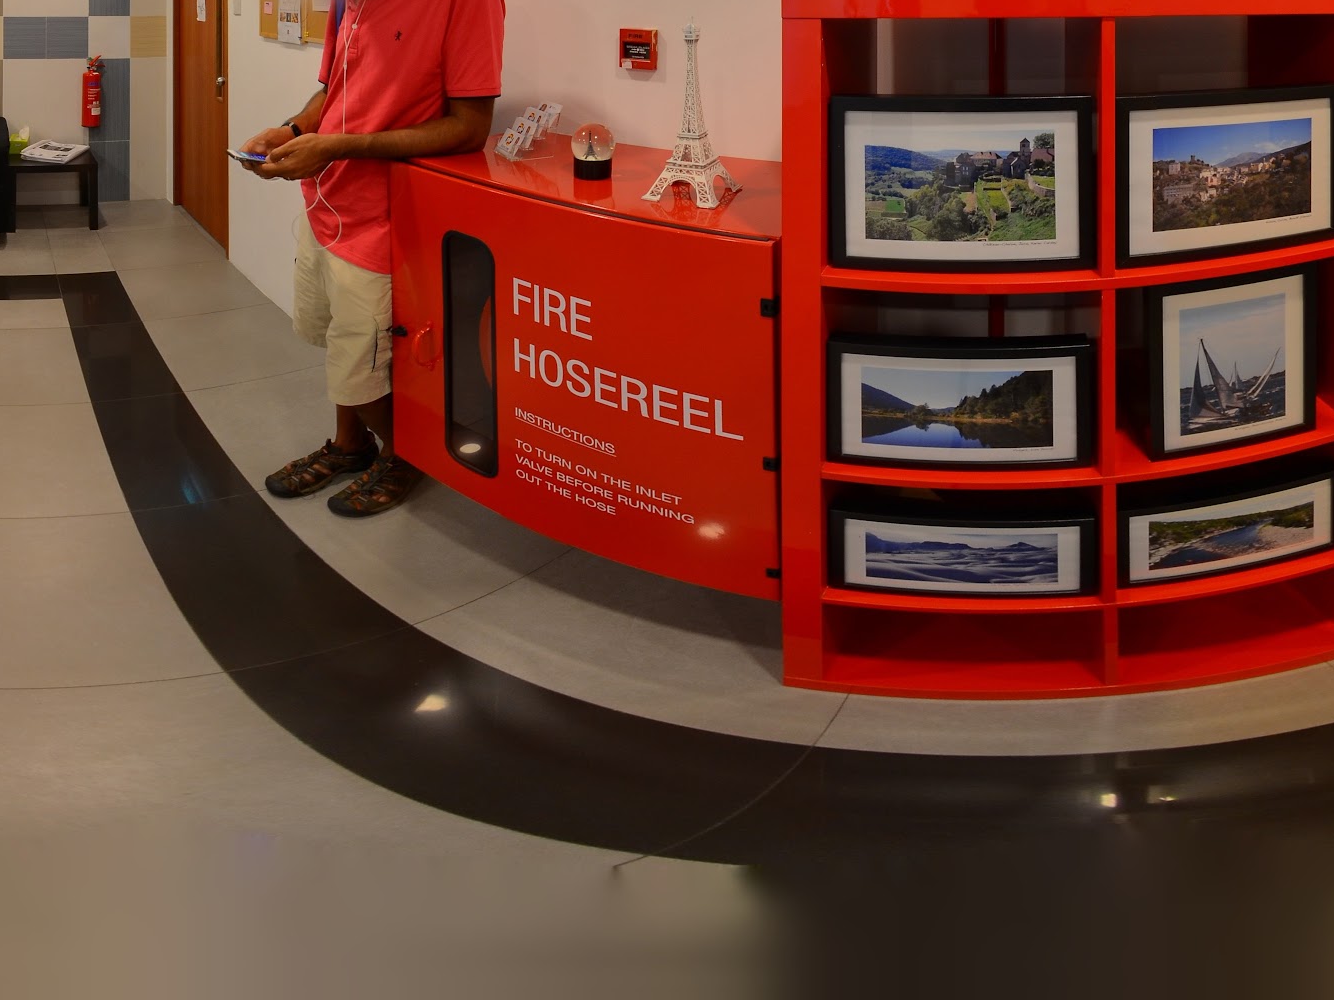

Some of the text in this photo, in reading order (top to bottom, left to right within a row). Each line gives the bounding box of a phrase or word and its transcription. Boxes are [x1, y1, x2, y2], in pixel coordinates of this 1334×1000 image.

[513, 277, 593, 341] FIRE
[513, 337, 744, 441] HOSEREEL
[514, 406, 616, 455] INSTRUCTIONS
[515, 438, 683, 506] TO TURN ON THE INLET
[515, 453, 695, 525] VALVE BEFORE RUNNING
[515, 468, 617, 516] OUT THE HOSE
